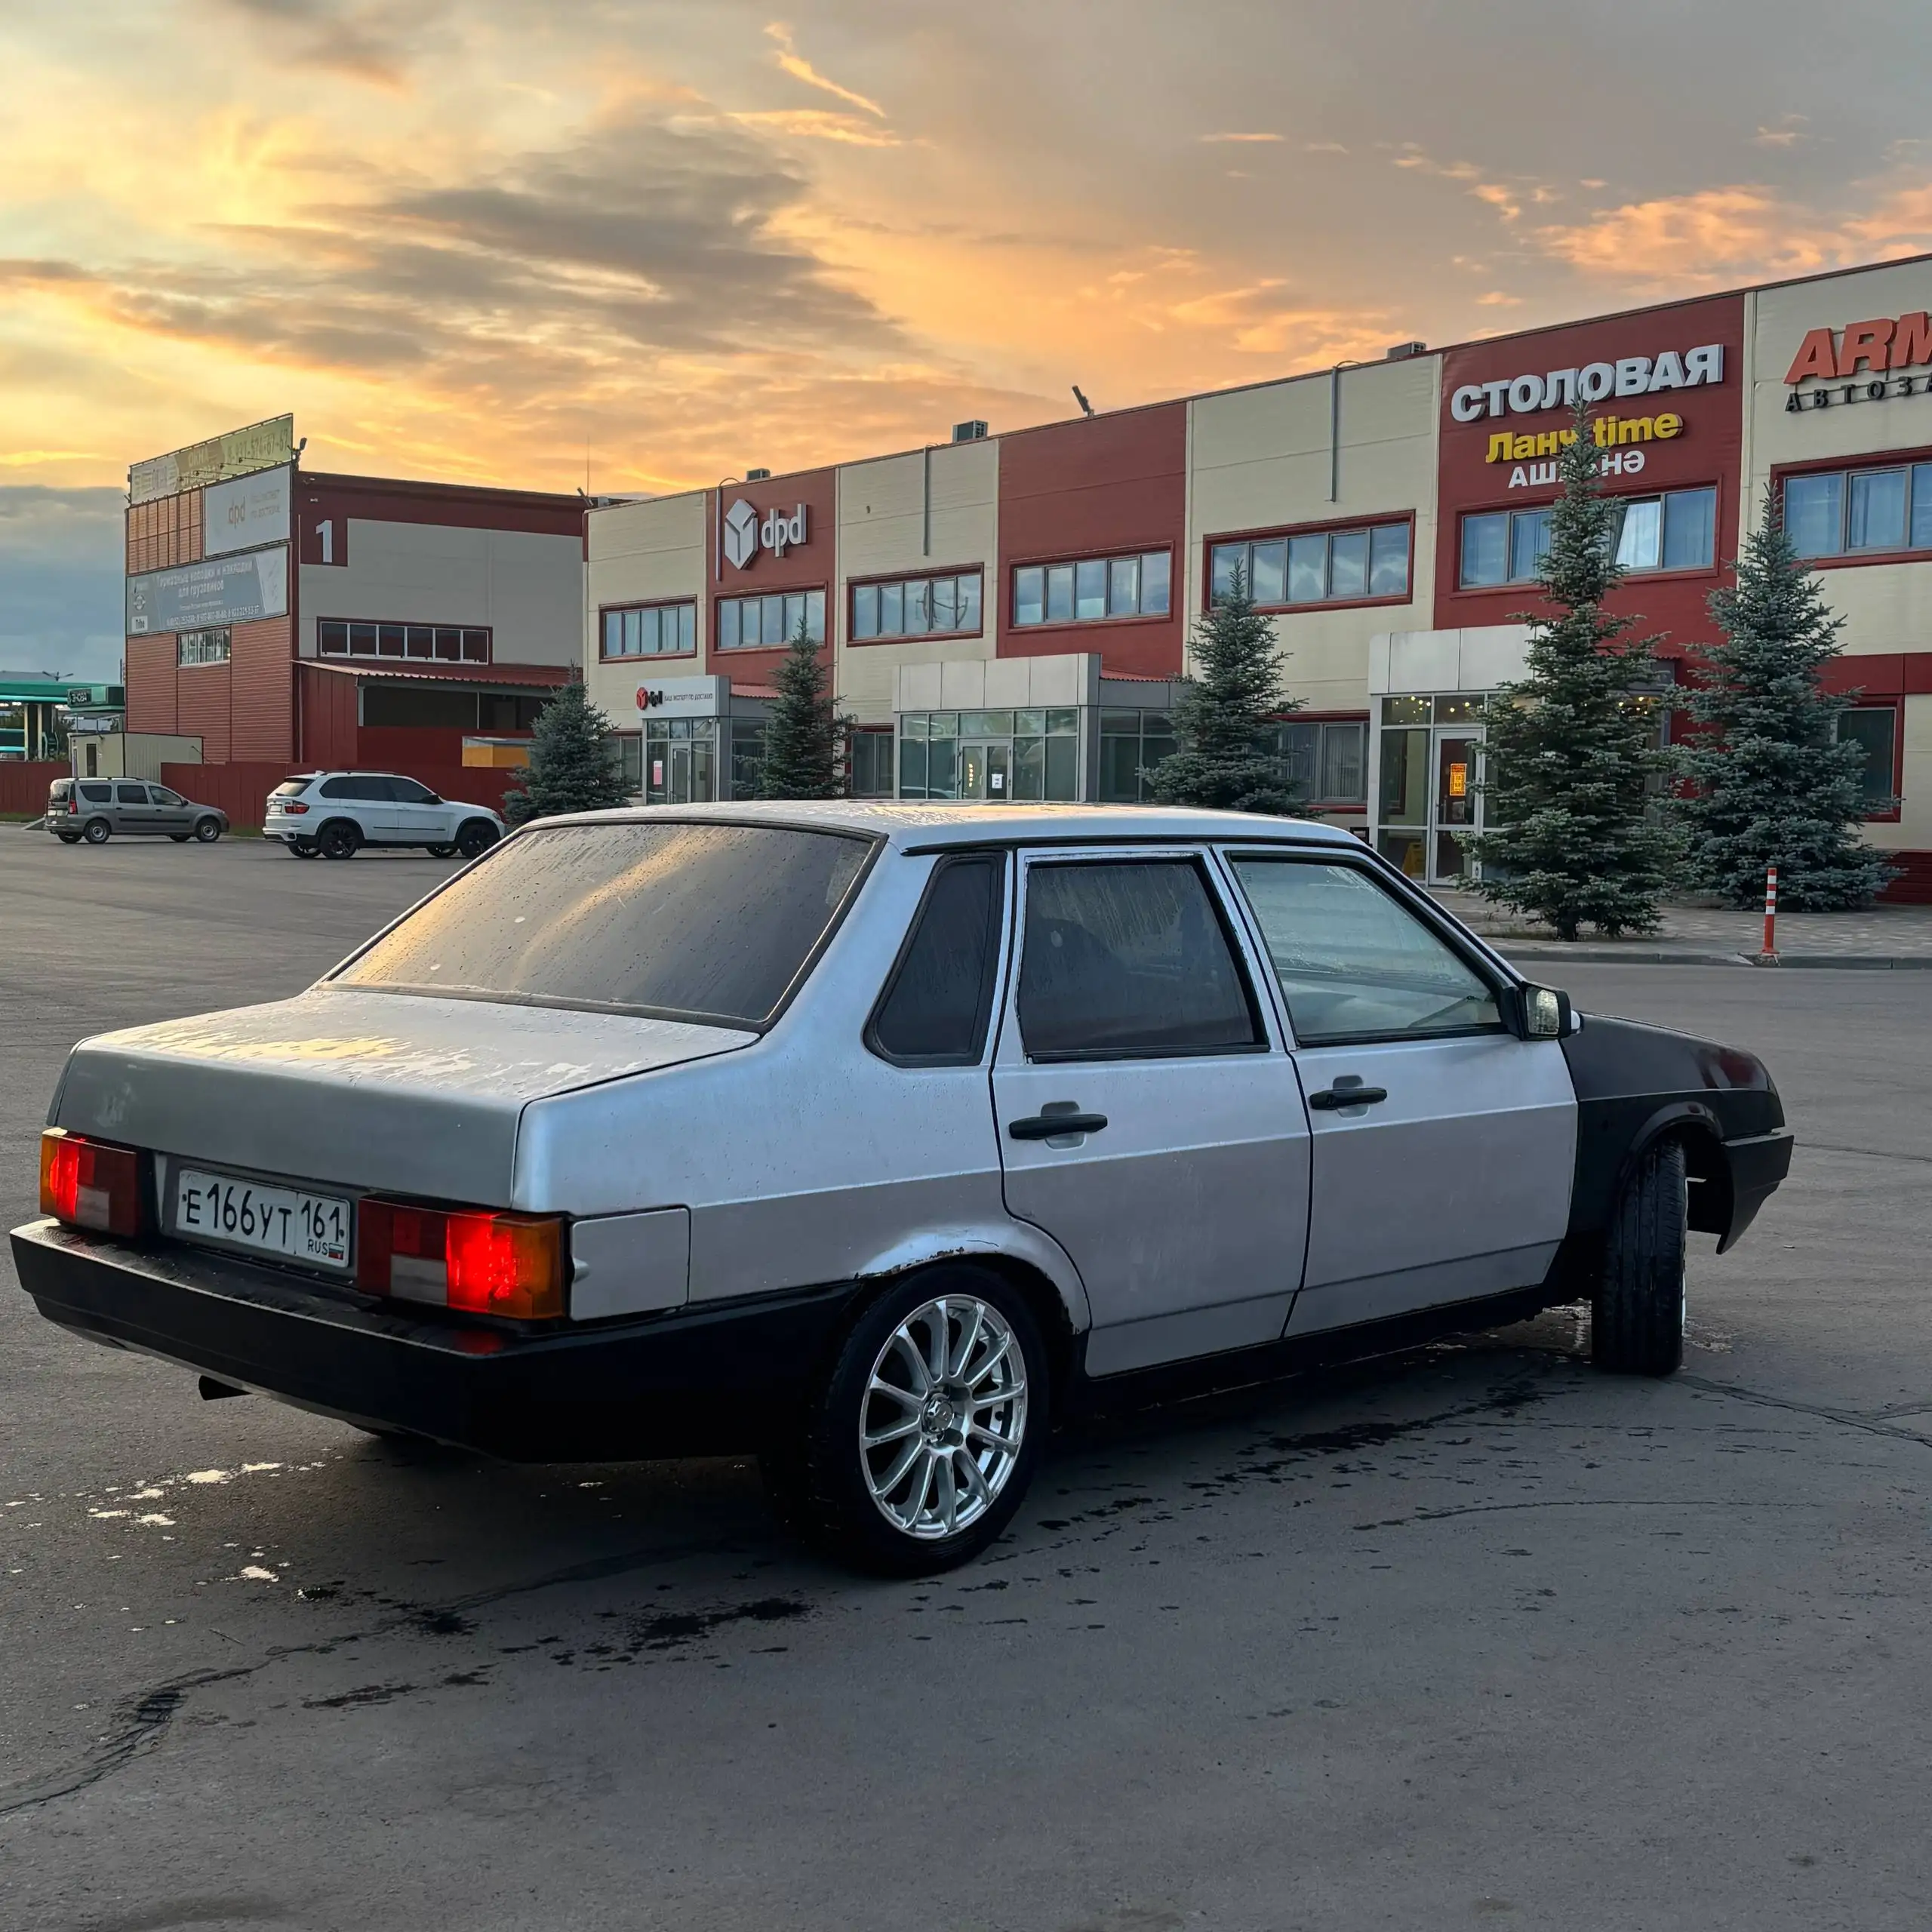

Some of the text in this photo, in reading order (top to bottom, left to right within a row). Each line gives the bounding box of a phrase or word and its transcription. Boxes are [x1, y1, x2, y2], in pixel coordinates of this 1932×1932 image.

[1783, 311, 1932, 385] ARM
[1451, 343, 1724, 423] СТОЛОВАЯ
[1593, 412, 1683, 448] time
[1508, 450, 1645, 488] АШНӘ
[315, 520, 333, 563] 1
[761, 503, 806, 557] dpd
[301, 1199, 340, 1242] 161
[307, 1238, 328, 1256] RUS
